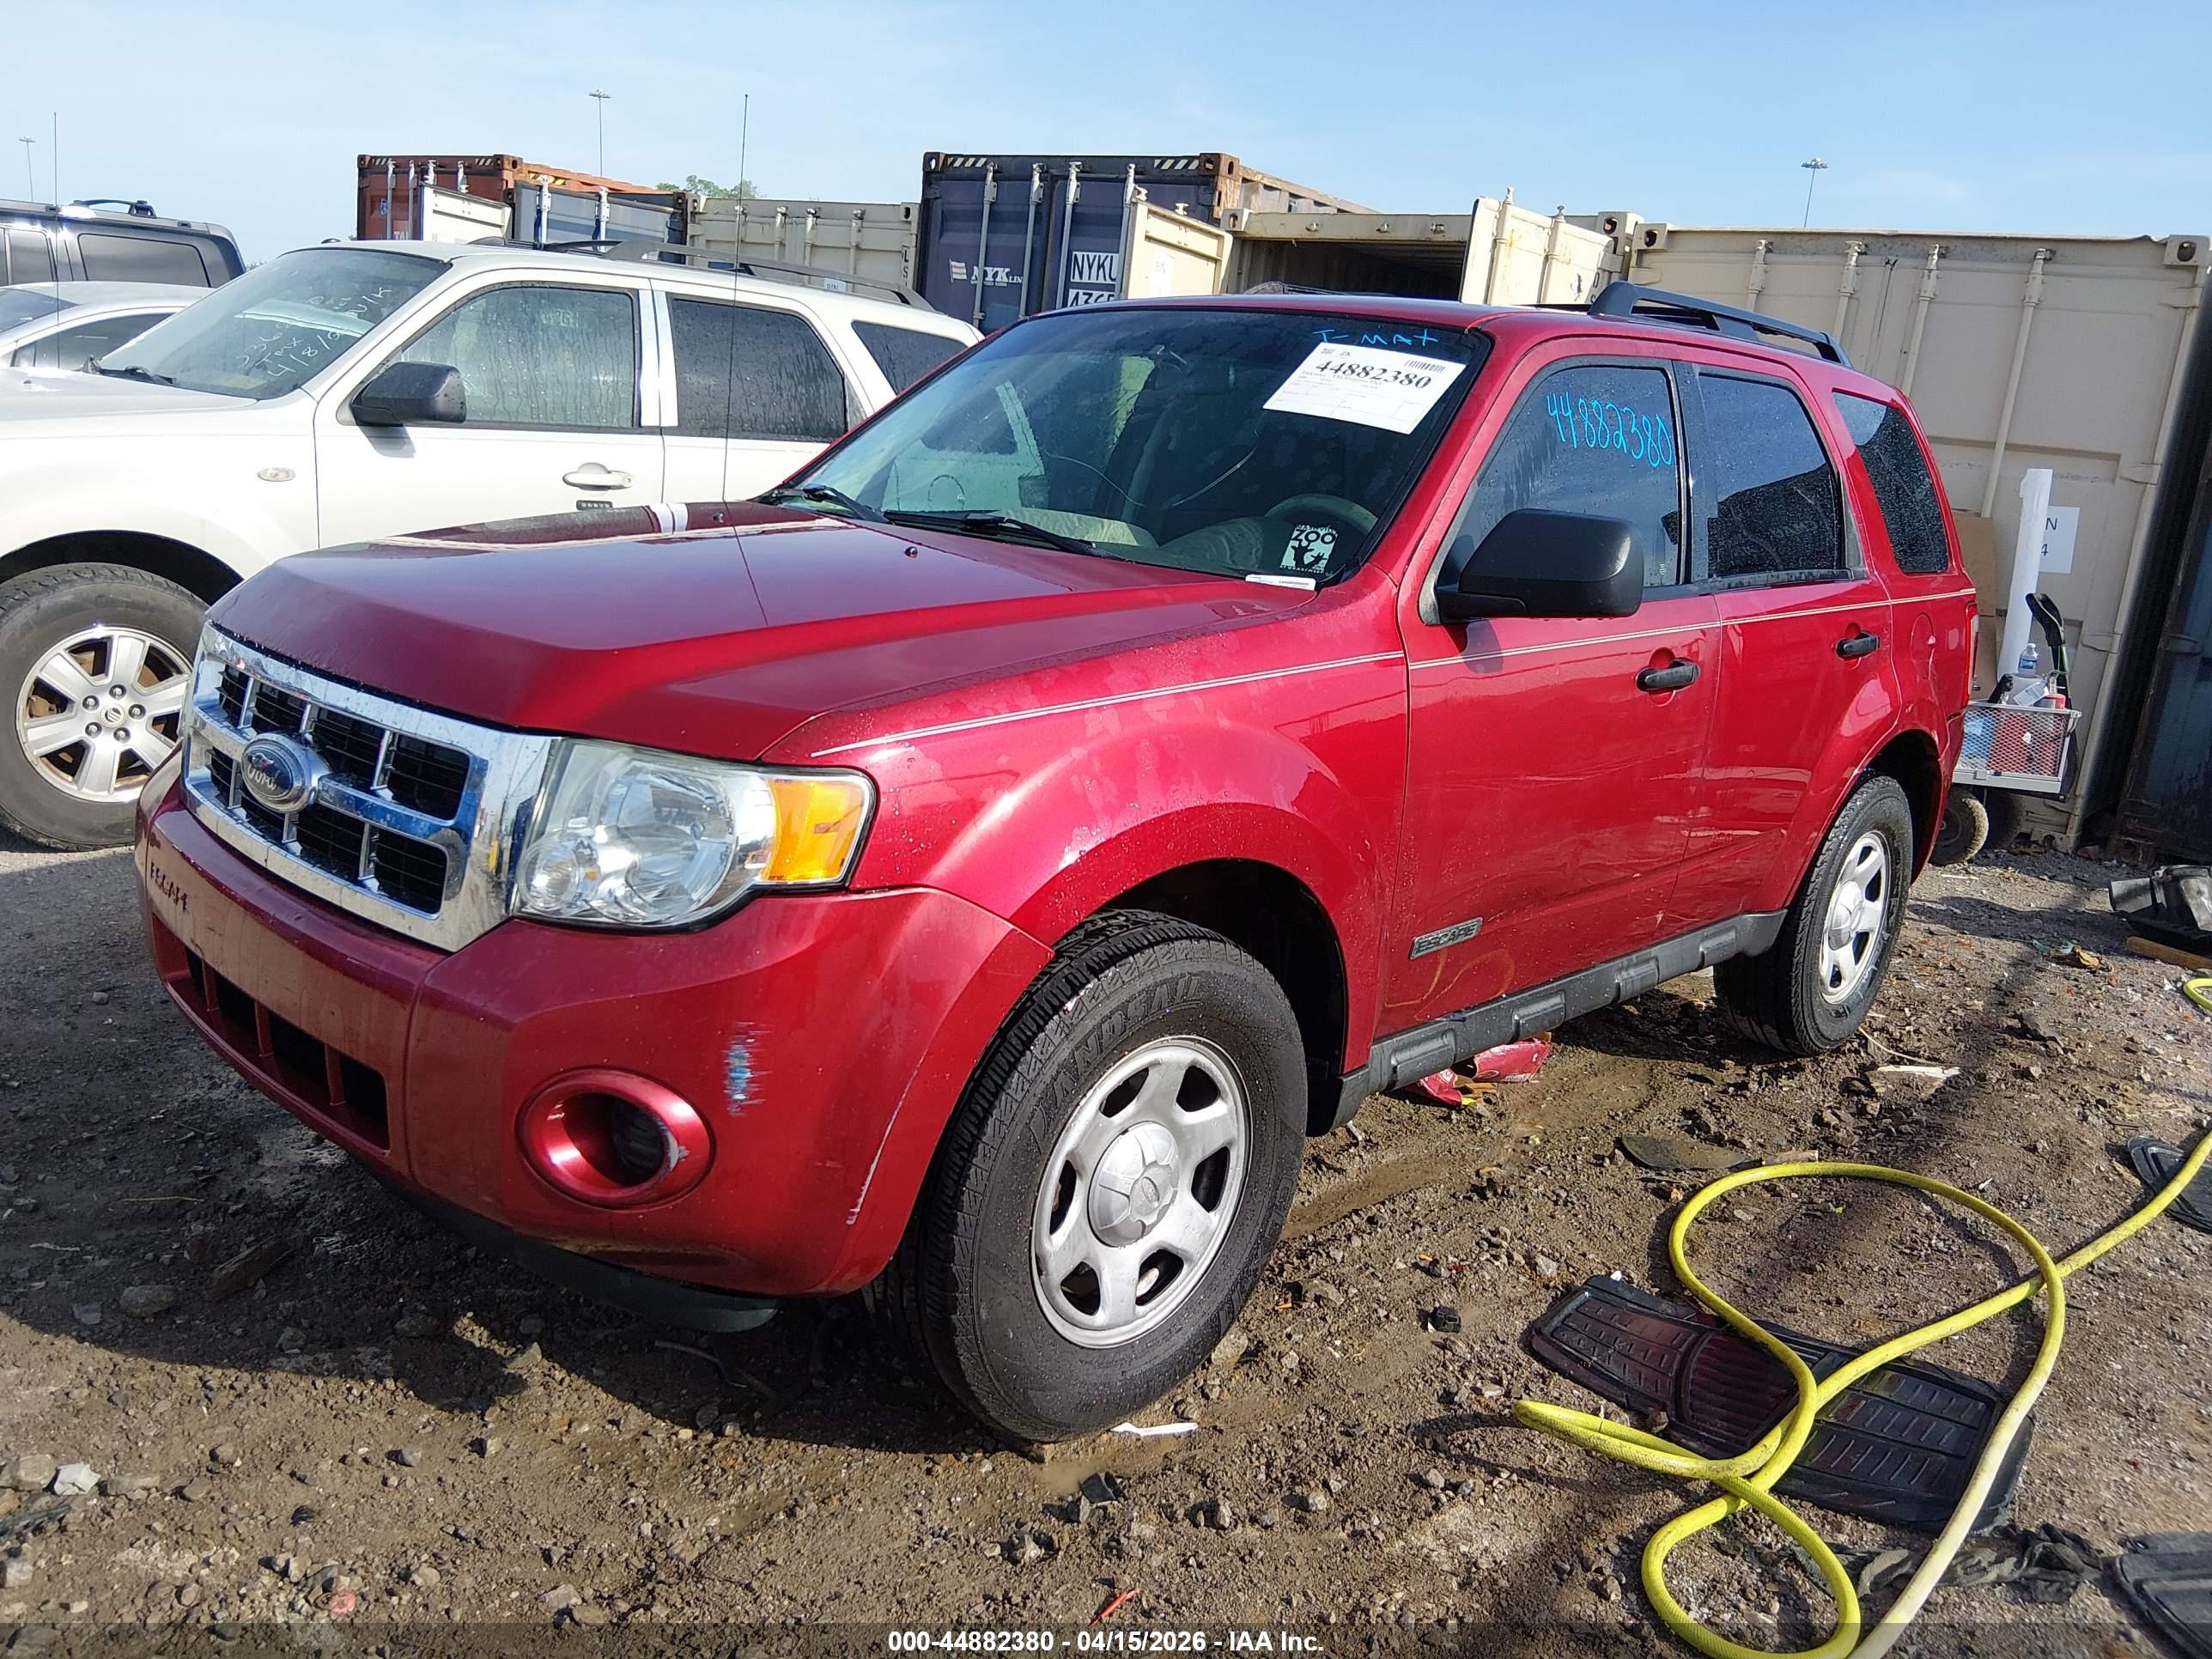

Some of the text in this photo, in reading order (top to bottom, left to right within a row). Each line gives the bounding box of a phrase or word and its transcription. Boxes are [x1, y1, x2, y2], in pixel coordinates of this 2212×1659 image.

[1316, 361, 1431, 389] 44882380
[1547, 392, 1673, 467] 44882380
[1291, 529, 1336, 544] ZOO
[1416, 924, 1478, 954] ESCAPE
